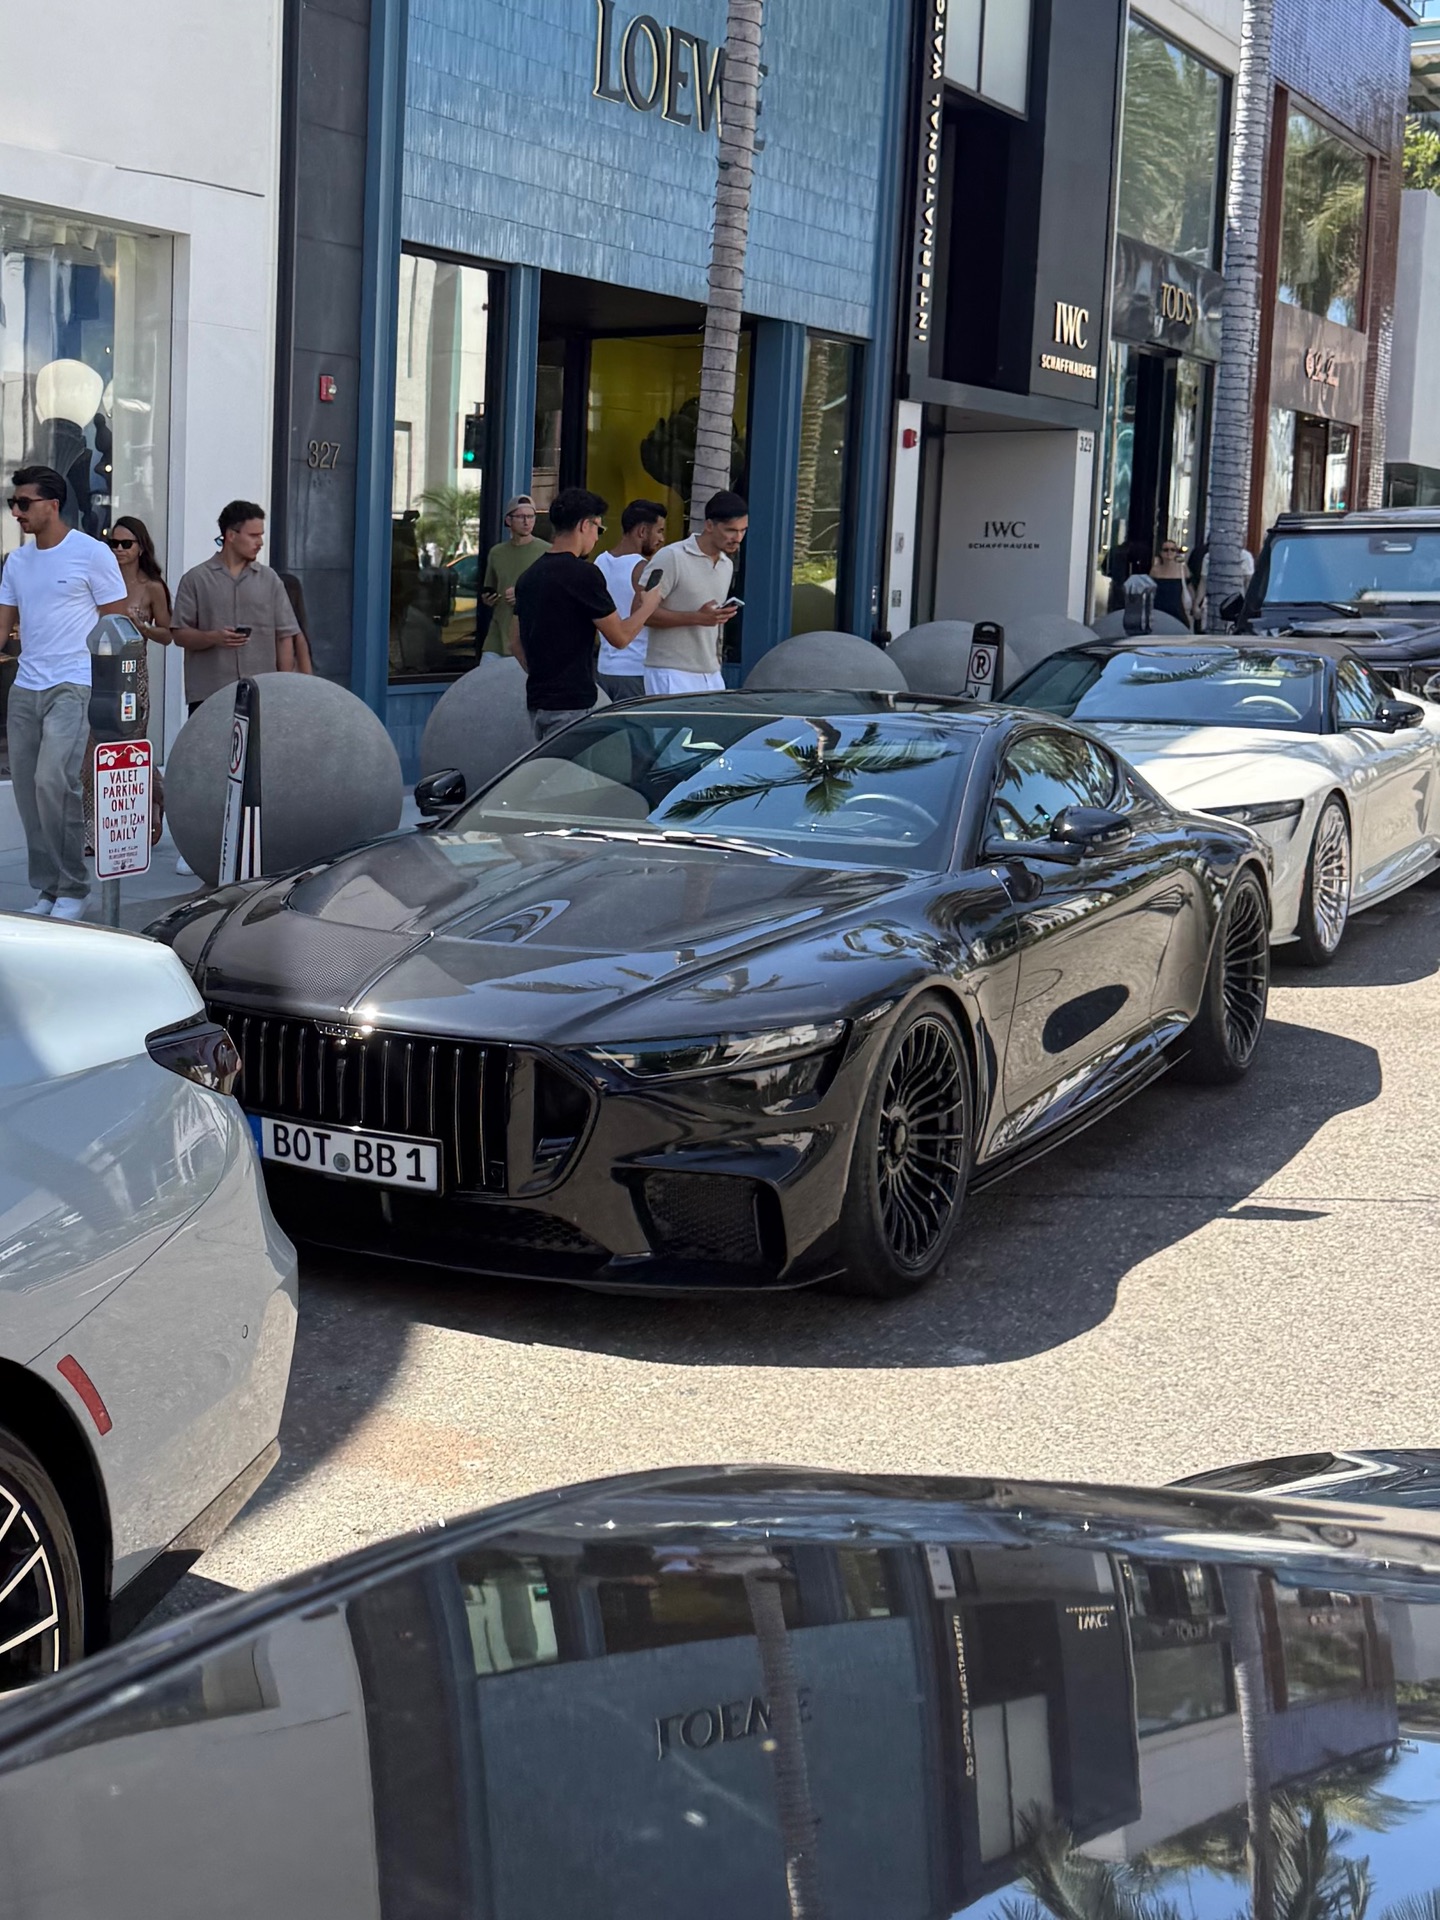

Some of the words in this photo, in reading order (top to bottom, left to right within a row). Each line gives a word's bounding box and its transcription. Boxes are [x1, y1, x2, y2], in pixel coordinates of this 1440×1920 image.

[593, 0, 768, 152] LOEW
[917, 93, 942, 342] INTERNATIONAL
[1054, 301, 1089, 350] IWC
[1040, 353, 1097, 380] SCHAFFHAUSEN
[308, 440, 341, 469] 327
[984, 521, 1026, 538] IWC
[110, 769, 138, 785] VALET
[103, 782, 144, 800] PARKING
[111, 797, 136, 812] ONLY
[102, 816, 119, 830] 10AM
[121, 815, 127, 826] TO
[110, 827, 137, 842] DAILY
[273, 1123, 331, 1166] BOT
[354, 1139, 397, 1178] BB
[406, 1148, 426, 1182] 1
